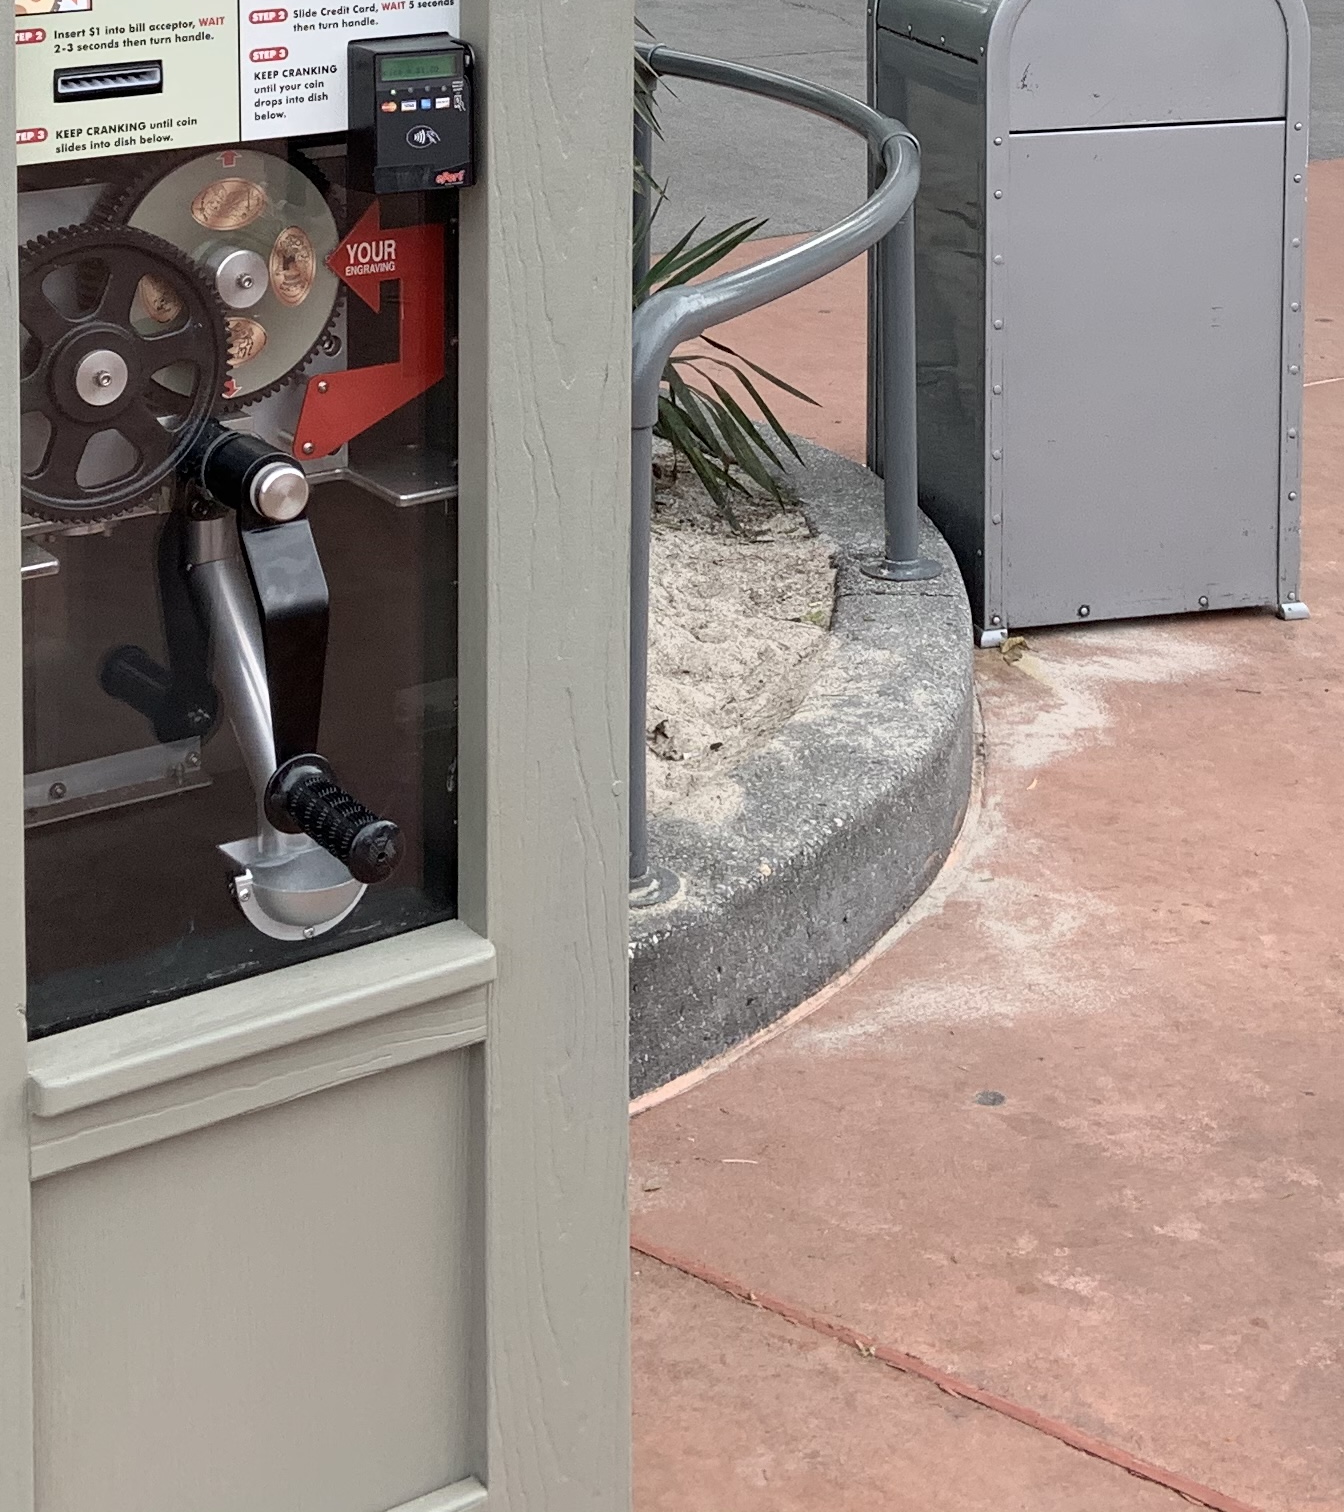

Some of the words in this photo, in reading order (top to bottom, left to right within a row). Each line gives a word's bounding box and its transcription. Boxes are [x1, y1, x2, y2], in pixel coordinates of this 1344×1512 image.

[252, 12, 275, 21] STEP
[293, 9, 317, 19] Slide
[321, 6, 350, 16] Credit
[353, 3, 378, 14] Card,
[381, 1, 406, 10] WAIT
[409, 0, 414, 9] 5
[54, 30, 86, 39] Insert
[89, 26, 100, 37] $1
[105, 26, 125, 35] into
[129, 23, 145, 33] bill
[149, 20, 196, 31] acceptor,
[199, 17, 225, 26] WAIT
[293, 23, 315, 32] then
[318, 20, 338, 29] turn
[342, 17, 378, 27] handle.
[15, 32, 31, 41] TEP
[35, 32, 43, 40] 2
[54, 43, 74, 53] 2-3
[77, 40, 119, 52] seconds
[123, 38, 146, 47] then
[150, 35, 171, 44] turn
[175, 32, 214, 42] handle.
[253, 51, 276, 60] STEP
[279, 50, 286, 58] 3
[254, 71, 278, 81] KEEP
[282, 65, 337, 78] CRANKING
[254, 84, 276, 94] until
[279, 83, 301, 94] your
[304, 80, 324, 89] coin
[254, 97, 282, 108] drops
[286, 94, 304, 104] into
[308, 92, 328, 102] dish
[254, 111, 286, 121] below.
[56, 129, 83, 139] KEEP
[86, 122, 146, 136] CRANKING
[150, 119, 173, 129] until
[177, 117, 197, 126] coin
[17, 132, 34, 141] TEP
[37, 131, 45, 139] 3
[56, 143, 87, 153] slides
[90, 140, 110, 149] into
[114, 137, 136, 147] dish
[140, 134, 173, 144] below.
[346, 240, 396, 264] YOUR
[345, 261, 395, 276] ENGRAVING
